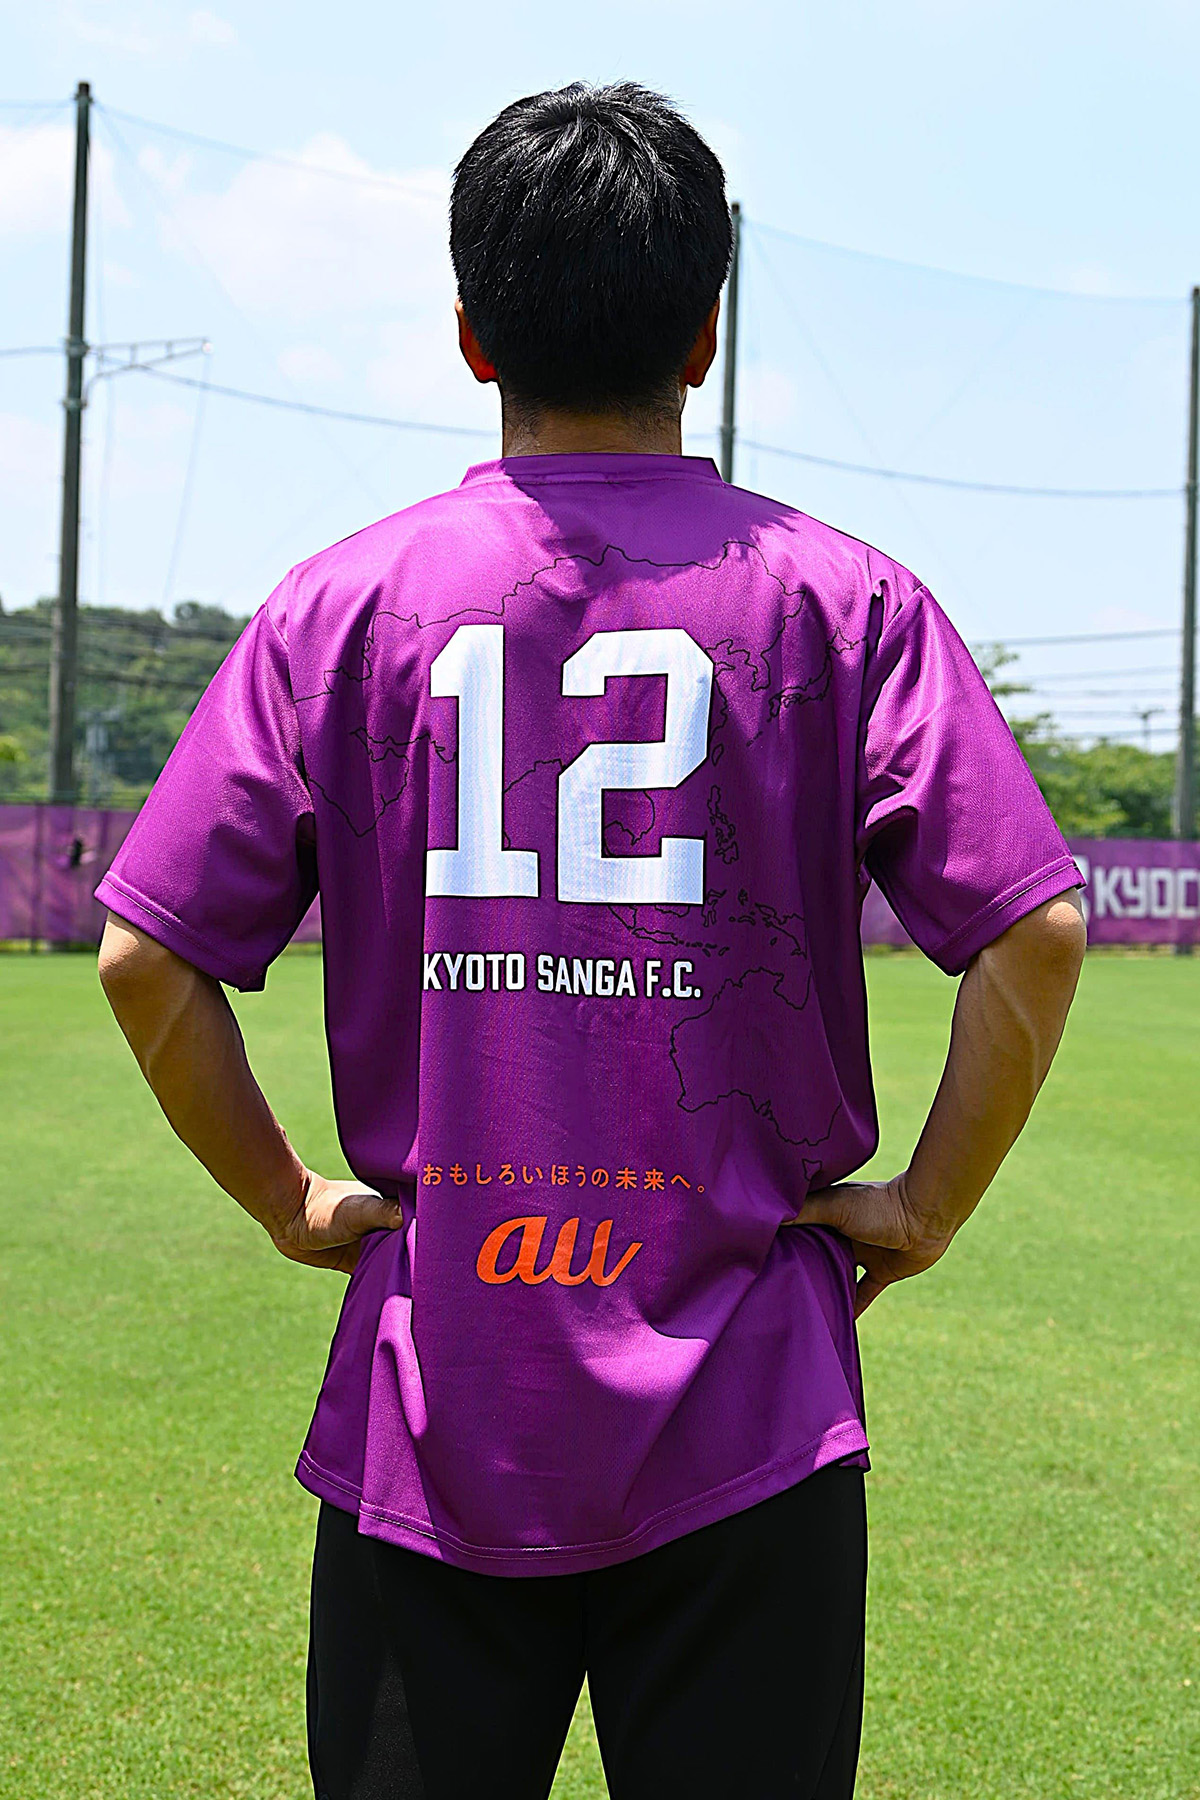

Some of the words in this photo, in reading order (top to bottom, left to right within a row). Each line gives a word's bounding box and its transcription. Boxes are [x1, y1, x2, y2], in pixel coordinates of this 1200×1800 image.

[425, 624, 714, 905] 12
[423, 953, 525, 991] KYOTO
[537, 954, 637, 998] SANGA
[646, 960, 702, 998] F.C.
[422, 1163, 705, 1193] おもしろいほうの未来へ。
[476, 1216, 643, 1286] au
